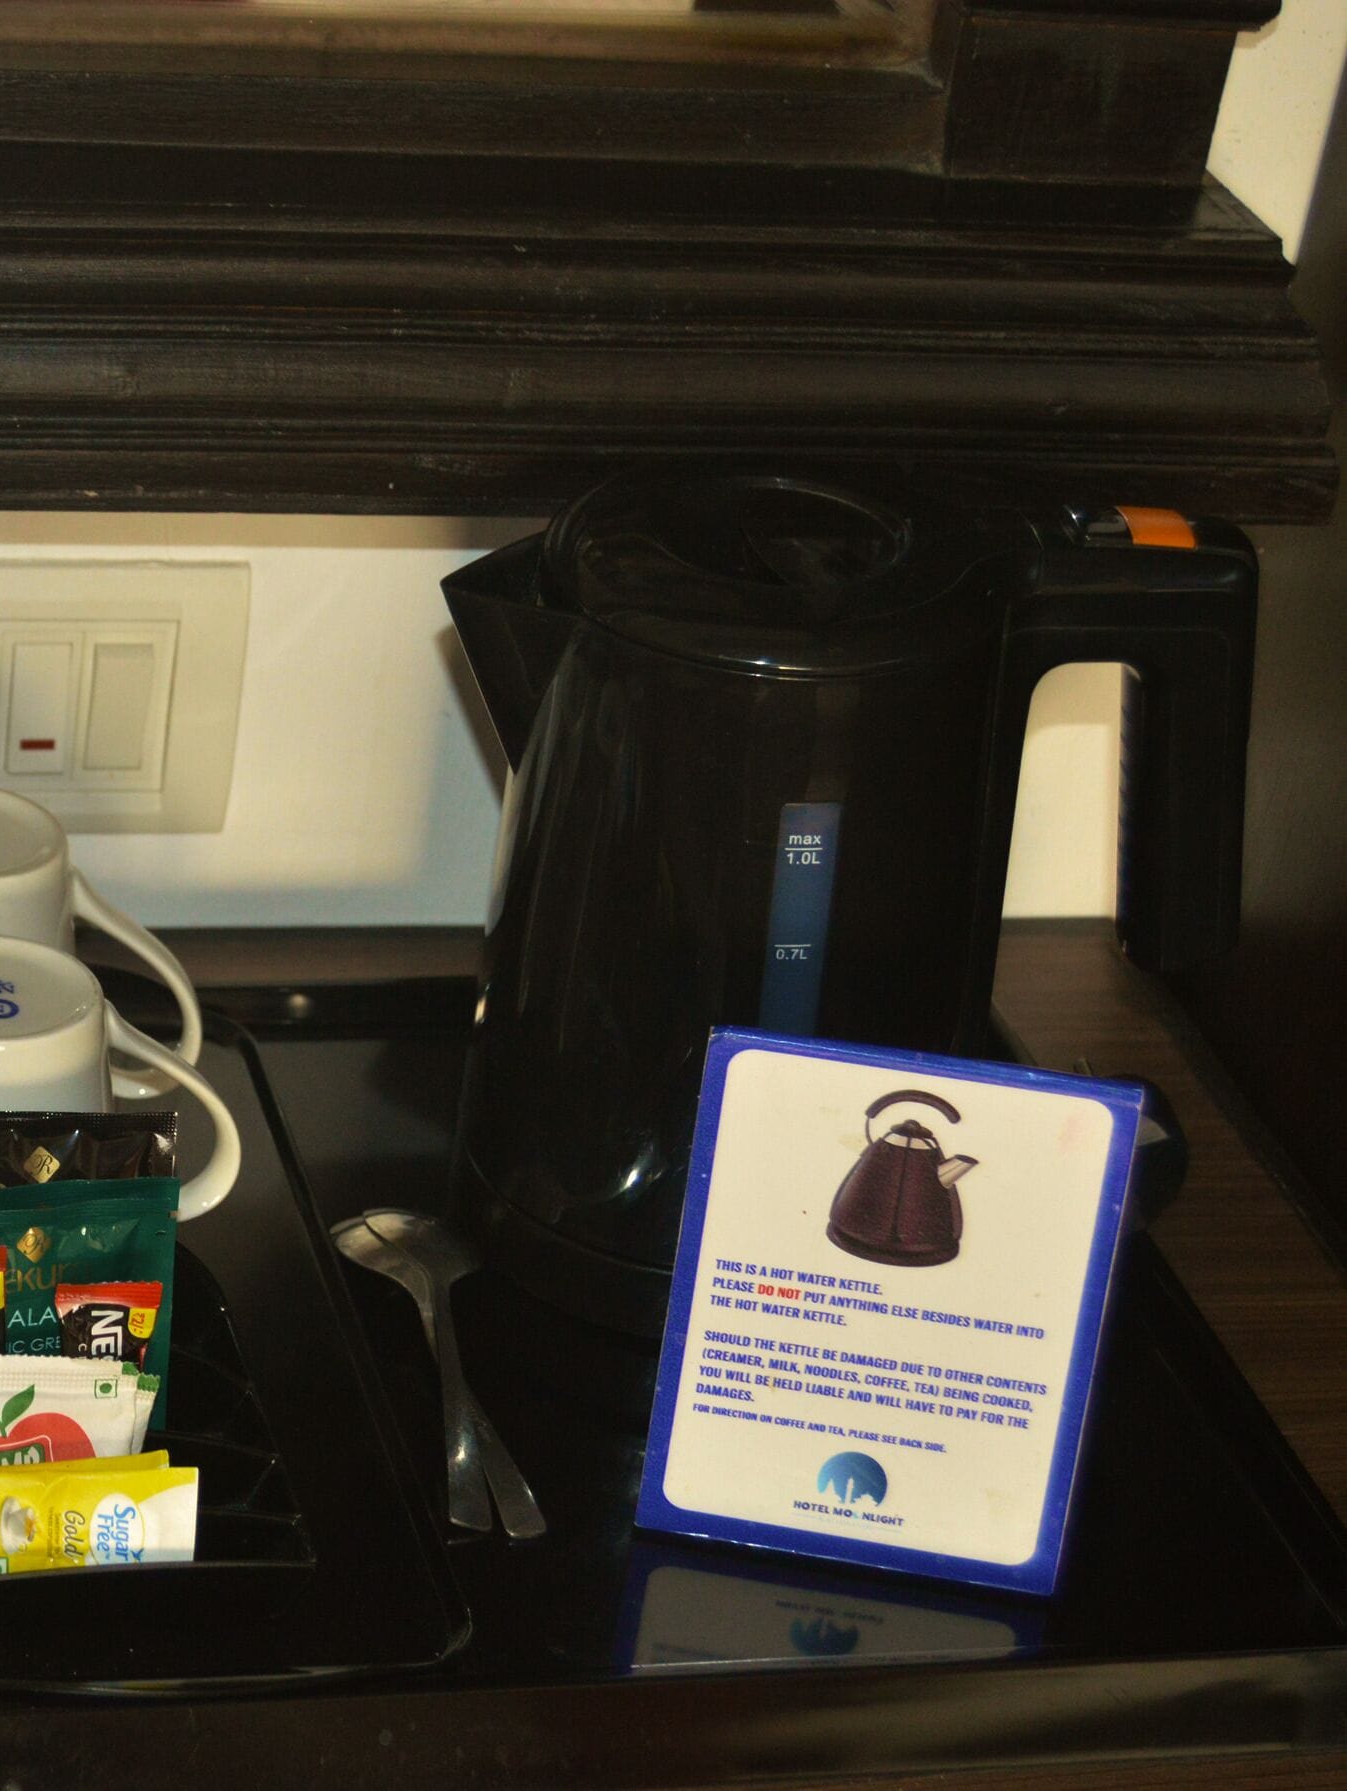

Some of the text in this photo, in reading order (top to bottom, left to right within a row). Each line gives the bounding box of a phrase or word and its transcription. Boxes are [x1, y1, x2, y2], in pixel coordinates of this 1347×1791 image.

[786, 852, 821, 865] 1.0L
[789, 834, 821, 845] max
[775, 948, 808, 960] 0.7L
[716, 1259, 883, 1295] THIS IS A HOT WATER KETTLE.
[710, 1295, 847, 1326] THE HOT WATER KETTLE.
[713, 1277, 1045, 1339] PLEASE DO NOT PUT ANYTHING ELSE BESIDES WATER INTO
[91, 1310, 124, 1360] NE
[703, 1348, 1033, 1412] (CREAMER, MILK, NOODLES, COFFEE, TEA) BEING COOKED,
[704, 1330, 1047, 1395] SHOULD THE KETTLE BE DAMAGED DUE TO OTHER CONTENTS
[696, 1382, 755, 1402] DAMAGES.
[699, 1366, 1029, 1430] YOU WILL BE HELD LIABLE AND WILL HAVE TO PAY FOR THE
[693, 1403, 947, 1453] FOR DIRECTION ON COFFEE AND TEA, PLEASE SEE BACK SIDE.
[793, 1500, 829, 1514] HOTEL
[64, 1510, 86, 1558] Gold
[111, 1504, 136, 1561] Sugar
